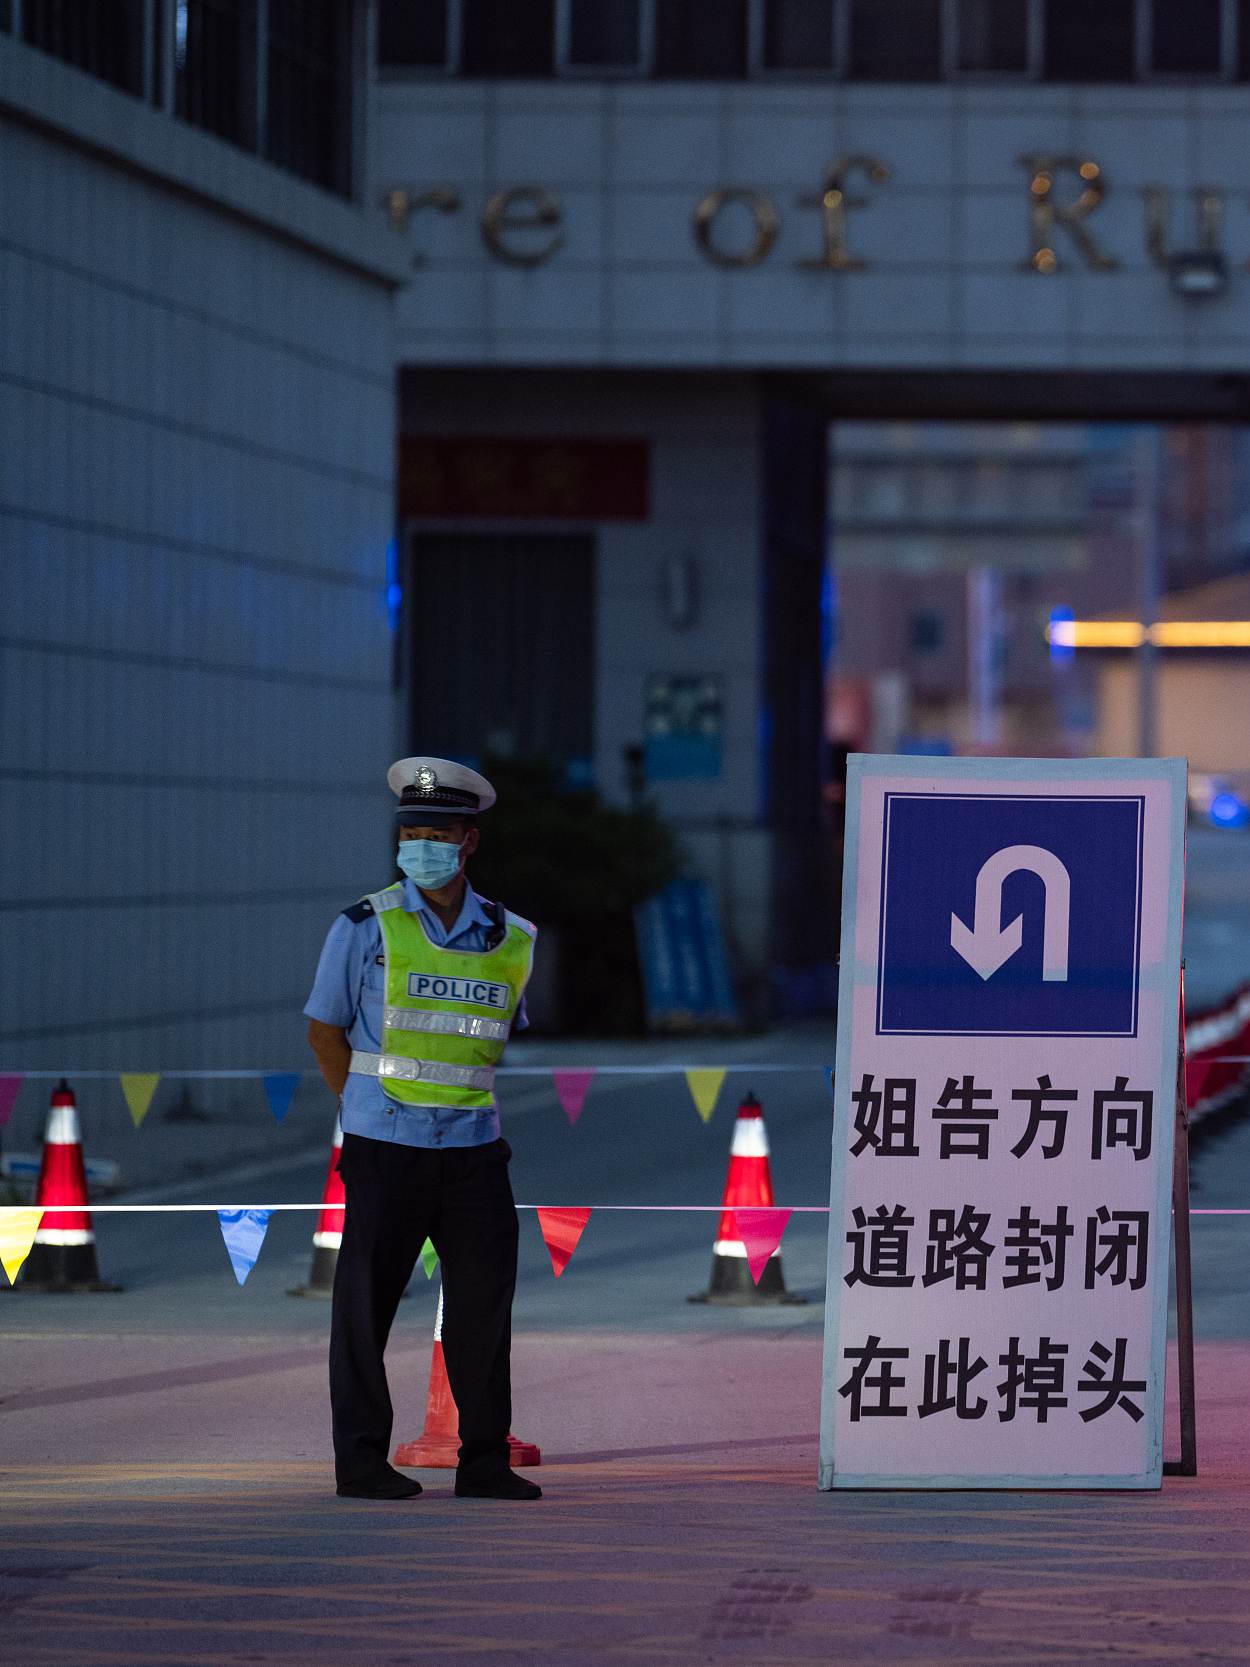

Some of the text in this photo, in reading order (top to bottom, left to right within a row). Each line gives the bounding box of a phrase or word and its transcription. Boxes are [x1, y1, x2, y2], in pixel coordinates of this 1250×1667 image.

[692, 151, 892, 272] of
[416, 976, 500, 1004] POLICE
[849, 1073, 1154, 1161] 姐告方向
[843, 1204, 1150, 1291] 道路封闭
[837, 1335, 1147, 1423] 在此掉头
